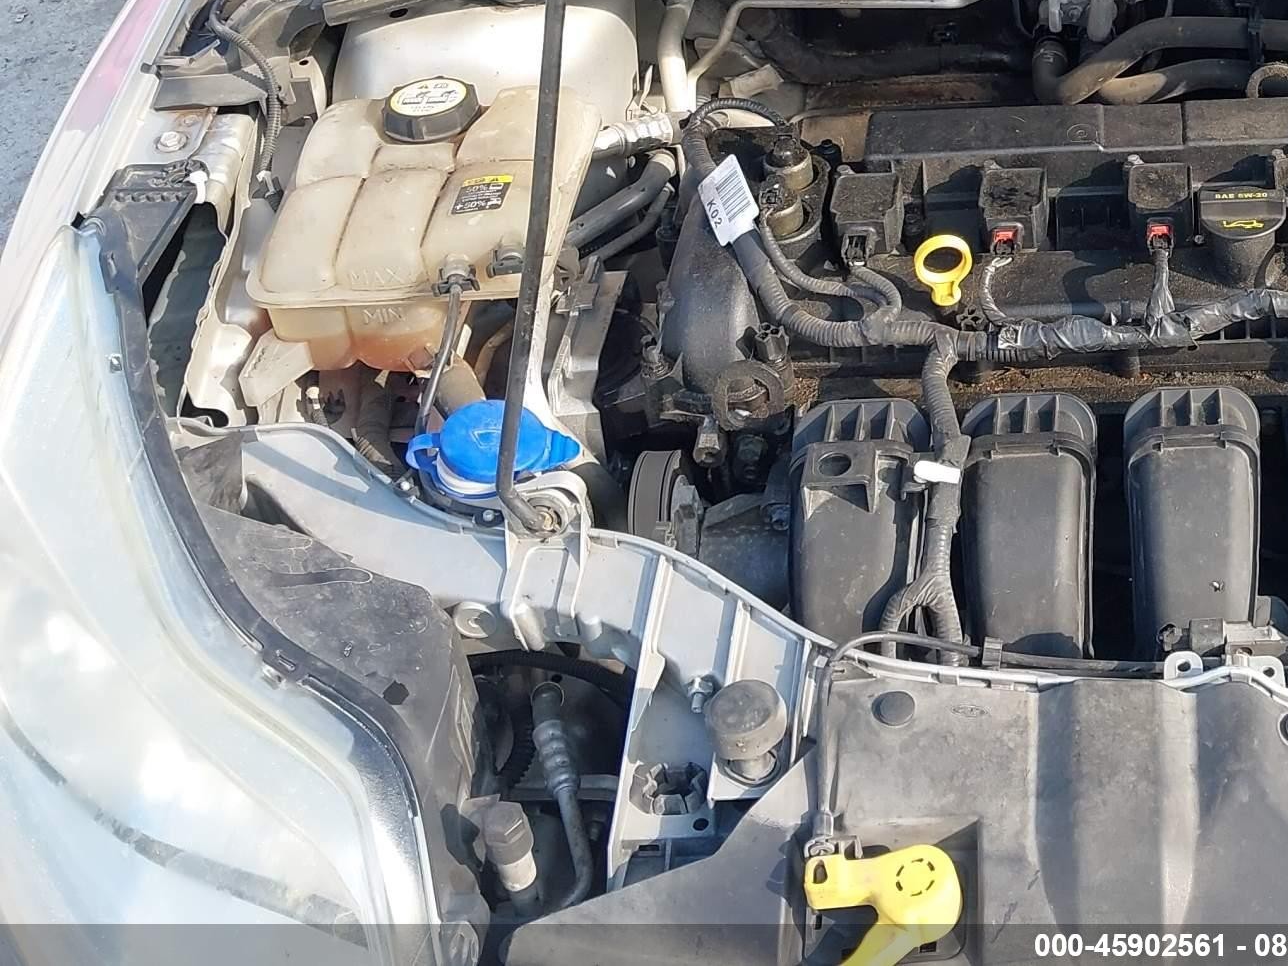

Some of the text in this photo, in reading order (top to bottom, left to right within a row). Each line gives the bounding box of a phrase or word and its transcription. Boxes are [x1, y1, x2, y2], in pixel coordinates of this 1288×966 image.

[706, 198, 723, 228] K02
[351, 267, 405, 284] MAX
[363, 307, 407, 325] MIN
